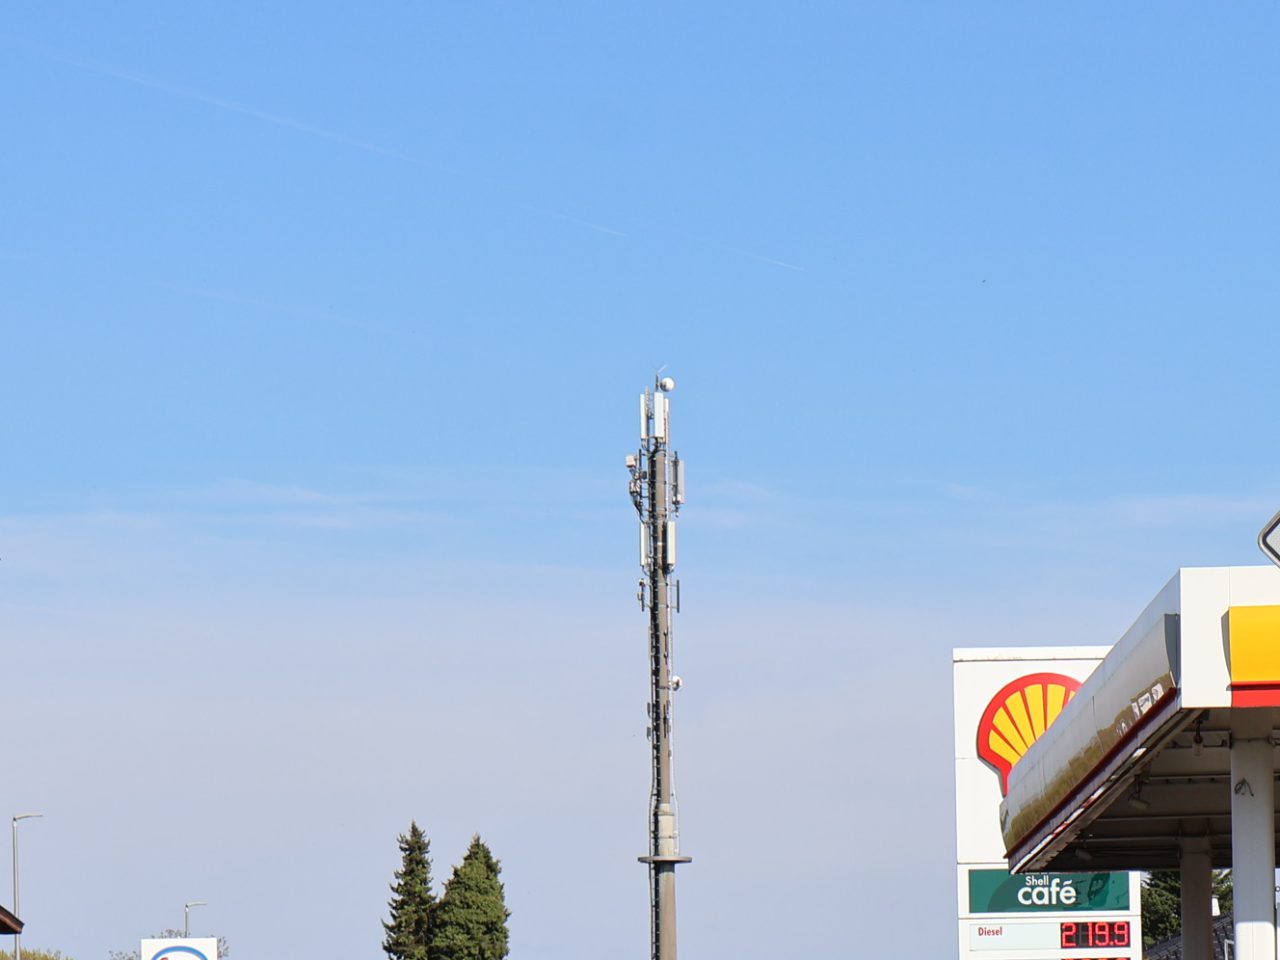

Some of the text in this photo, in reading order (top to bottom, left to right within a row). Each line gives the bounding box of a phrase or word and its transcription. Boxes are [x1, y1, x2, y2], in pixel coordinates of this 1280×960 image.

[1017, 877, 1077, 906] café
[1025, 875, 1050, 887] Shell
[978, 921, 1129, 947] Diesel 219.9
